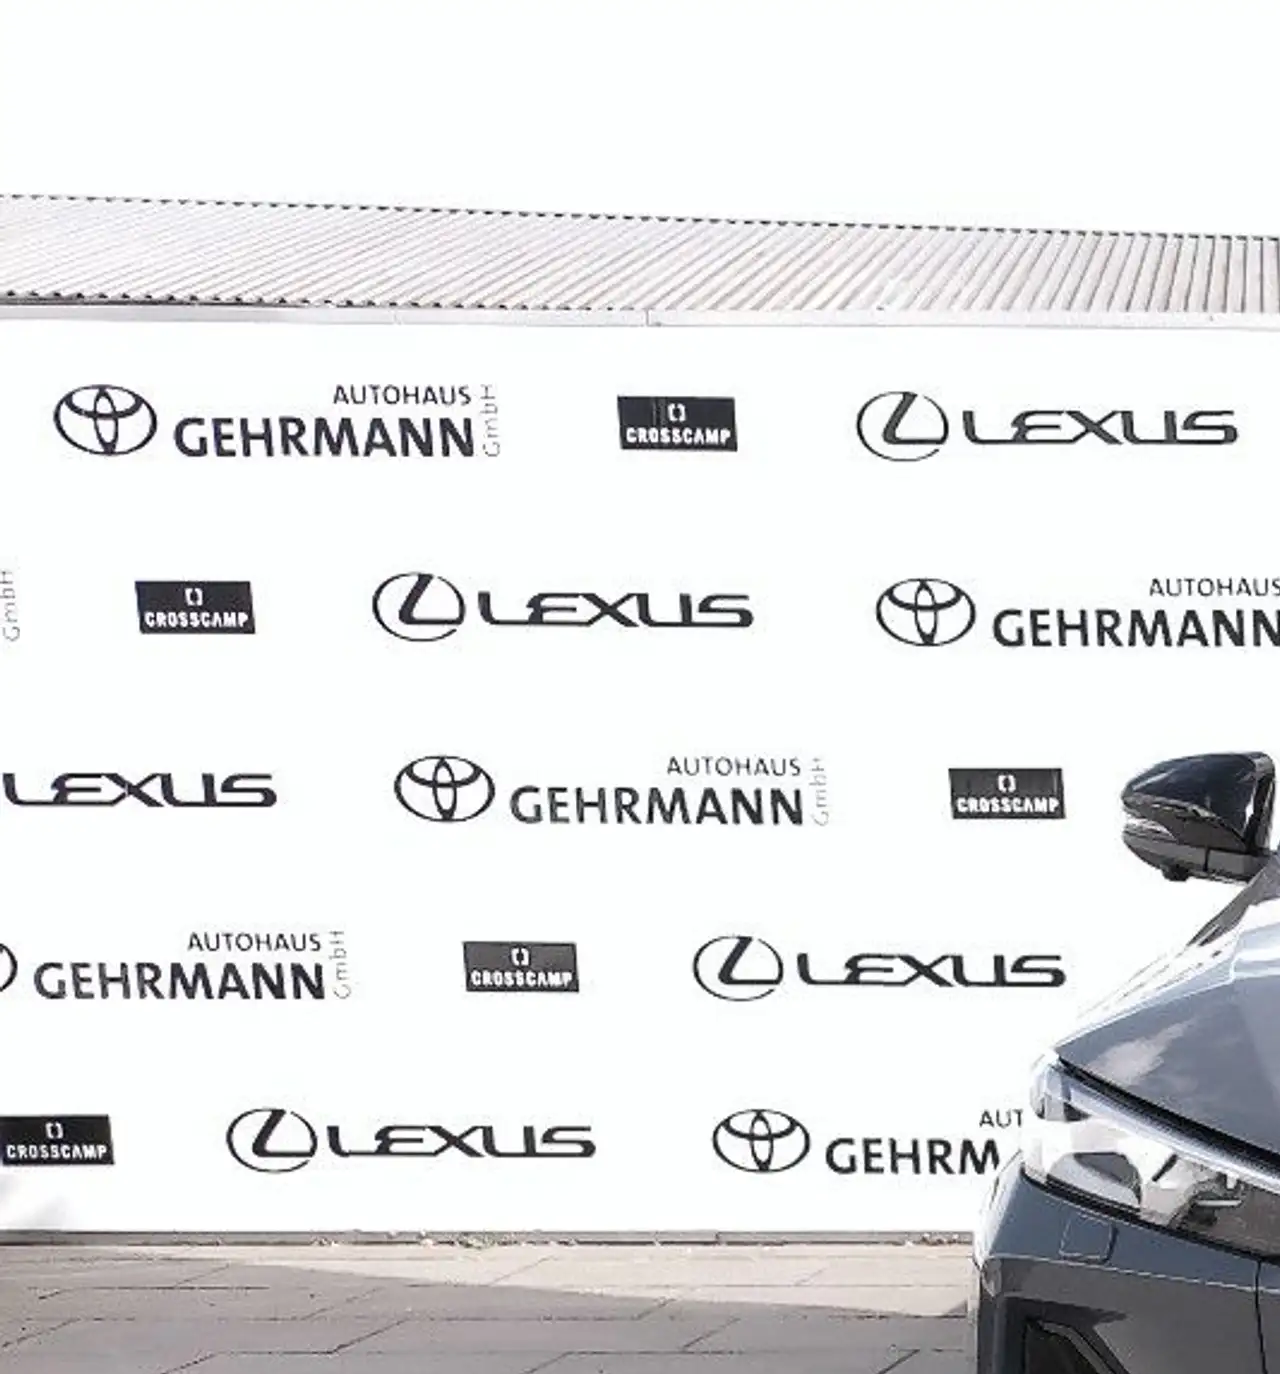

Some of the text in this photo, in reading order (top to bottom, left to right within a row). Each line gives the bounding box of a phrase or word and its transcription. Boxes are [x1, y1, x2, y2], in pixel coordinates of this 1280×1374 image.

[334, 385, 471, 405] AUTOHAUS
[174, 417, 474, 457] GEHRMANN
[480, 384, 500, 457] GmbH
[626, 425, 731, 445] CROSSCAMP
[963, 410, 1238, 445] LEXUS
[145, 609, 249, 628] CROSSCAMP
[478, 592, 754, 627] LEXUS
[667, 756, 800, 776] AUTOHAUS
[3, 773, 277, 807] LEXUS
[510, 786, 802, 825] GEHRMANN
[809, 758, 829, 826] GmbH
[957, 798, 1059, 813] CROSSCAMP
[188, 933, 321, 951] AUTOHAUS
[34, 962, 324, 999] GEHRMANN
[331, 931, 351, 999] GmbH
[471, 969, 573, 987] CROSSCAMP
[797, 953, 1066, 987] LEXUS
[7, 1145, 107, 1159] CROSSCAMP
[327, 1125, 596, 1157] LEXUS
[826, 1138, 999, 1175] GEHRM
